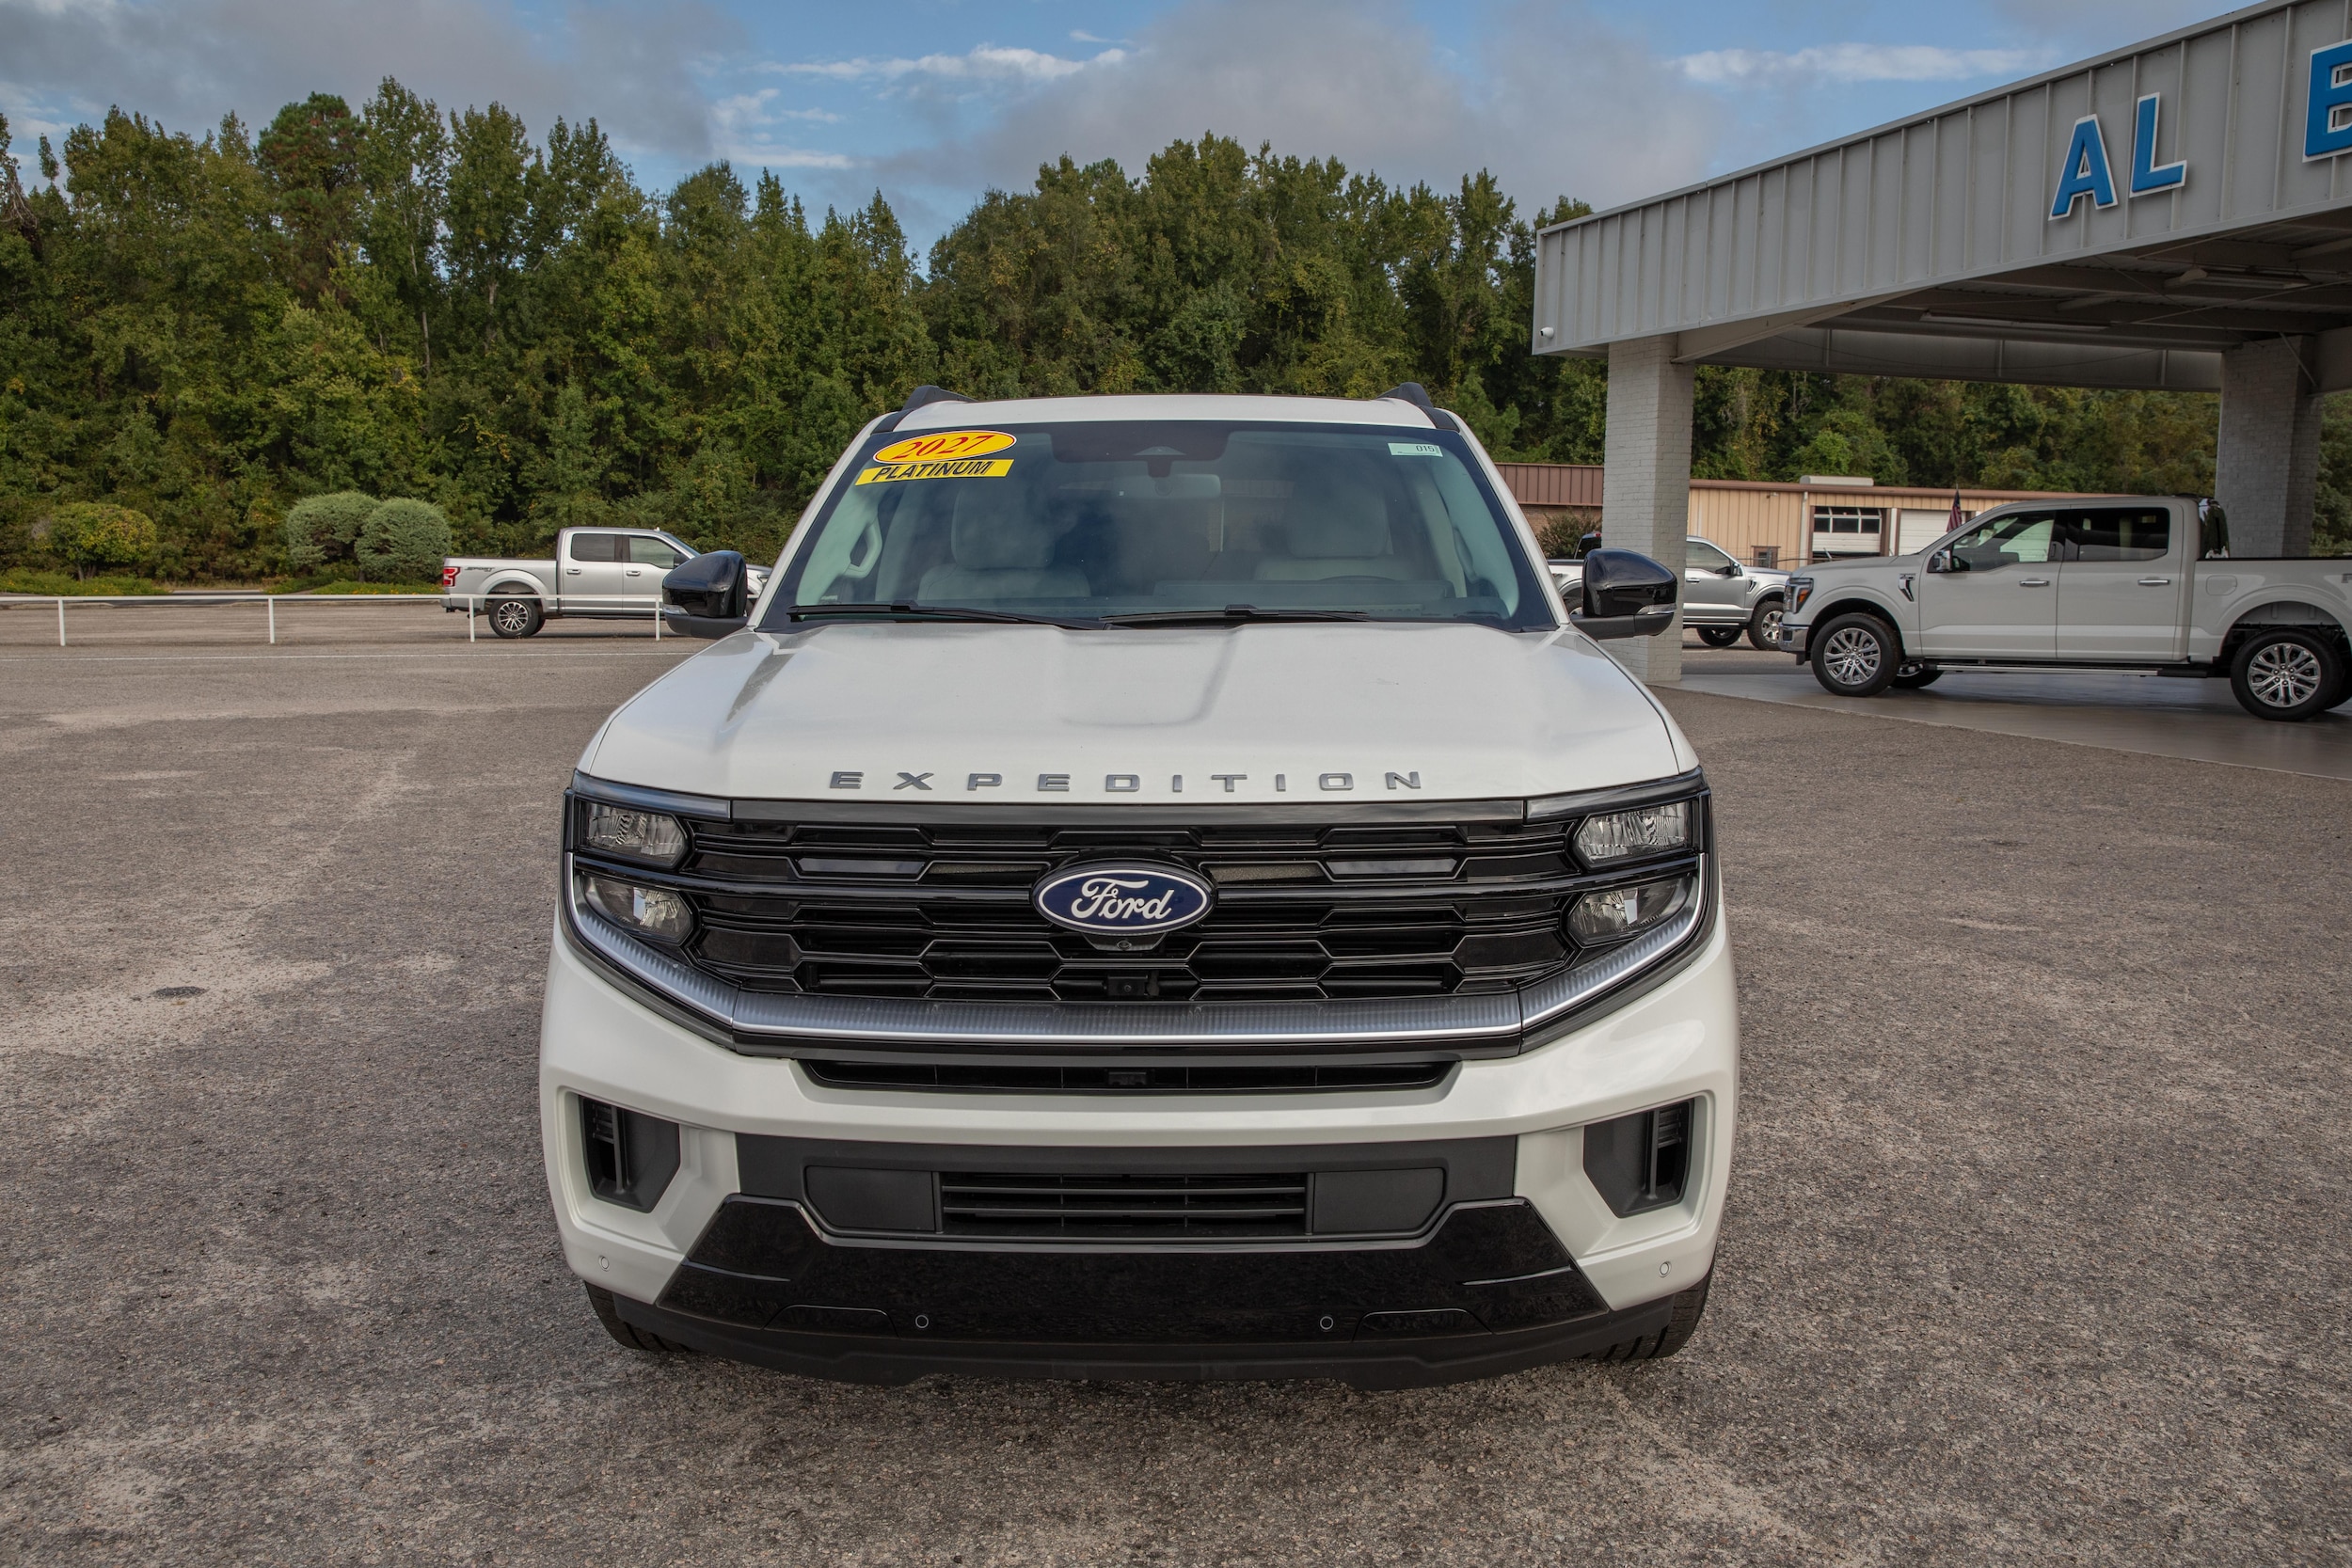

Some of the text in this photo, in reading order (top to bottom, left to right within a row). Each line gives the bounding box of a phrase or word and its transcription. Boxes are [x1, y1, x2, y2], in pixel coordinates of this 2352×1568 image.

[2048, 92, 2187, 221] AL
[891, 435, 995, 461] 2027
[871, 460, 995, 483] PLATINUM
[829, 770, 1422, 794] EXPEDITION
[1071, 878, 1175, 920] Ford
